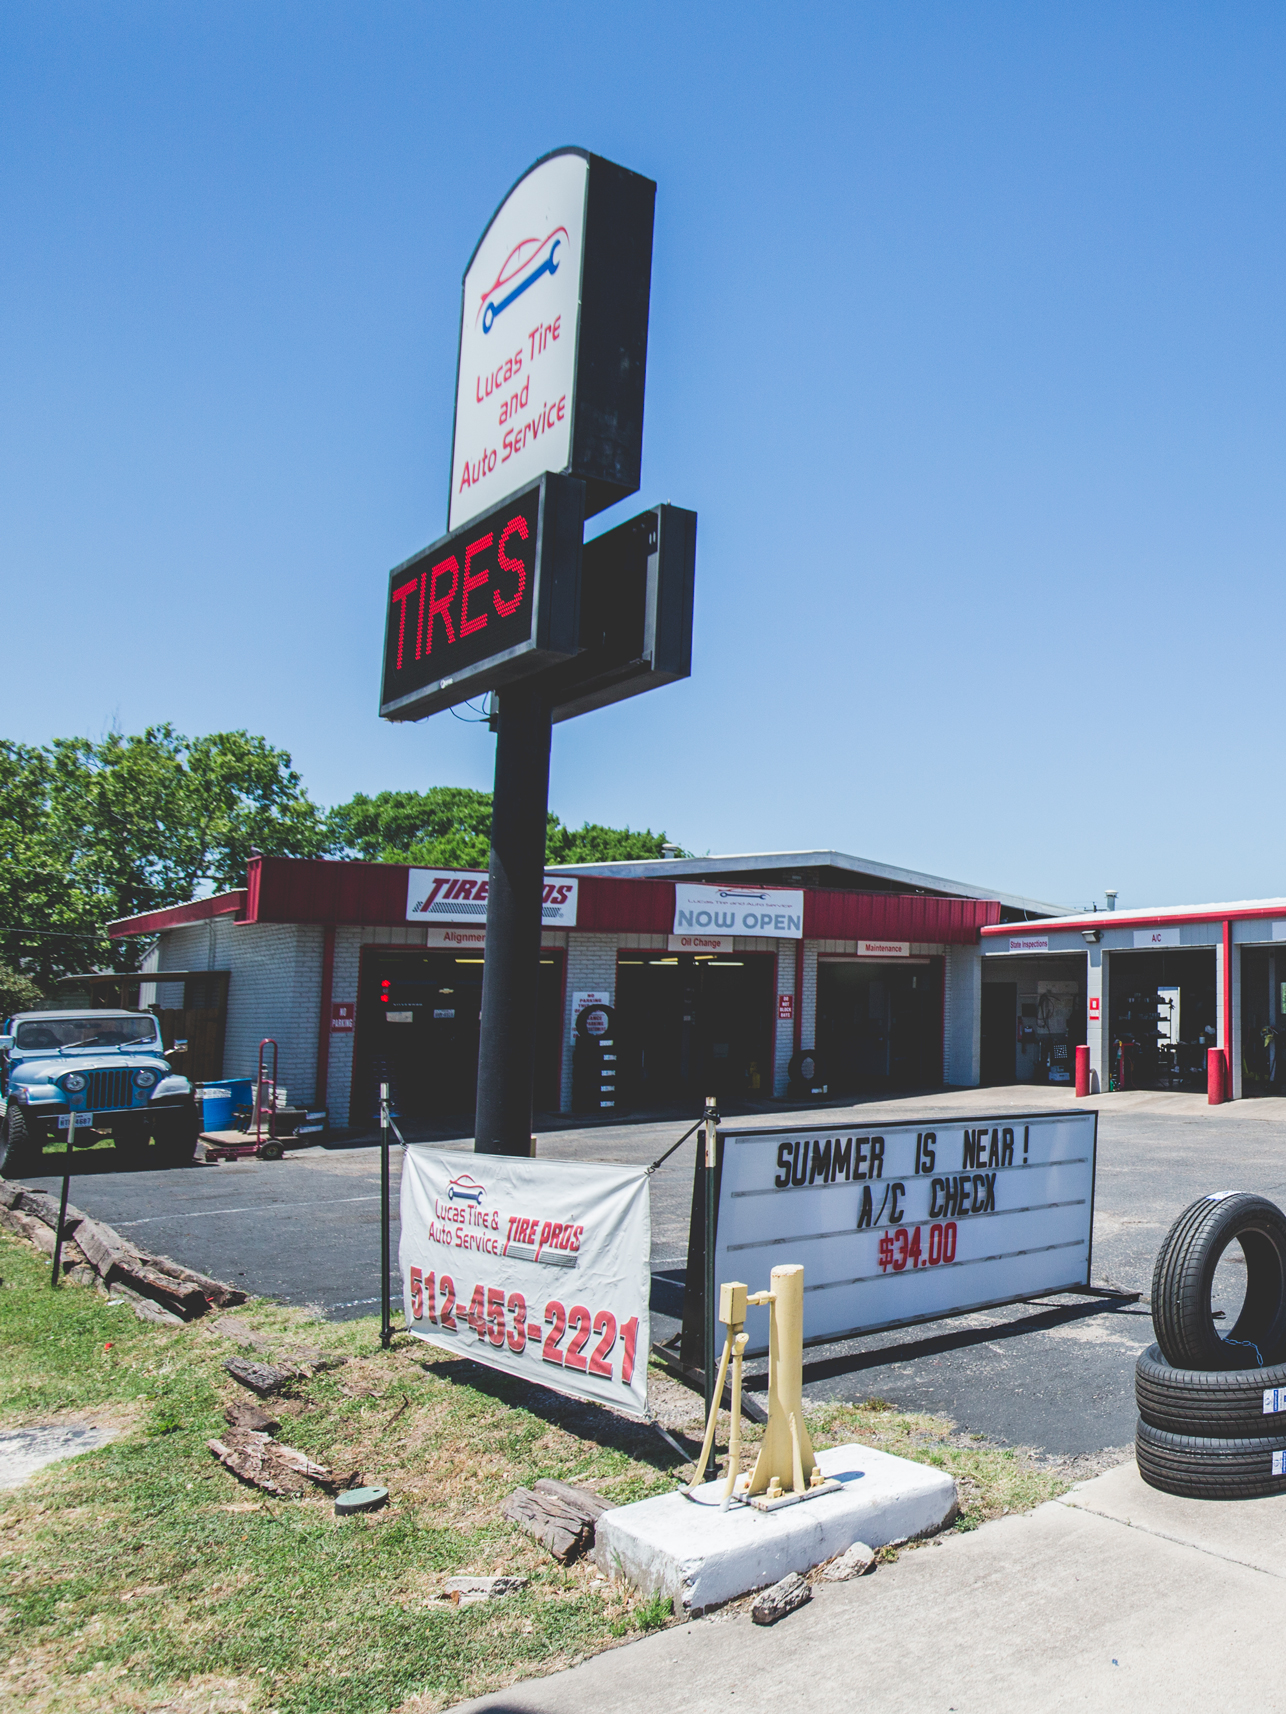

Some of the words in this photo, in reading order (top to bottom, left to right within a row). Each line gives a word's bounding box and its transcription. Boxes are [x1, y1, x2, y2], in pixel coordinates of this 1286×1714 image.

[475, 348, 523, 404] Lucas
[528, 314, 562, 361] Tire
[499, 374, 530, 426] and
[459, 447, 497, 494] Auto
[501, 394, 566, 464] Service
[392, 514, 529, 670] TIRES
[420, 878, 489, 912] TIRE
[678, 910, 735, 929] NOW
[742, 913, 800, 931] OPEN
[1151, 933, 1161, 943] A/C
[681, 937, 692, 946] Oil
[693, 938, 721, 949] Change
[865, 944, 902, 953] Maintenance
[1010, 940, 1021, 949] State
[1021, 938, 1048, 949] Inspections
[332, 1019, 353, 1028] PARKING
[340, 1007, 347, 1016] NO
[775, 1136, 885, 1188] SUMMER
[914, 1132, 937, 1175] IS
[435, 1198, 466, 1224] Lucas
[467, 1204, 489, 1229] Tire
[490, 1210, 499, 1231] &
[857, 1182, 906, 1229] A/C
[929, 1173, 997, 1219] CHECK
[428, 1221, 453, 1246] Auto
[455, 1226, 499, 1256] Service
[502, 1215, 541, 1257] TIRE
[533, 1221, 584, 1263] PROS
[879, 1221, 957, 1273] $34.00
[410, 1265, 640, 1387] 512-453-2221
